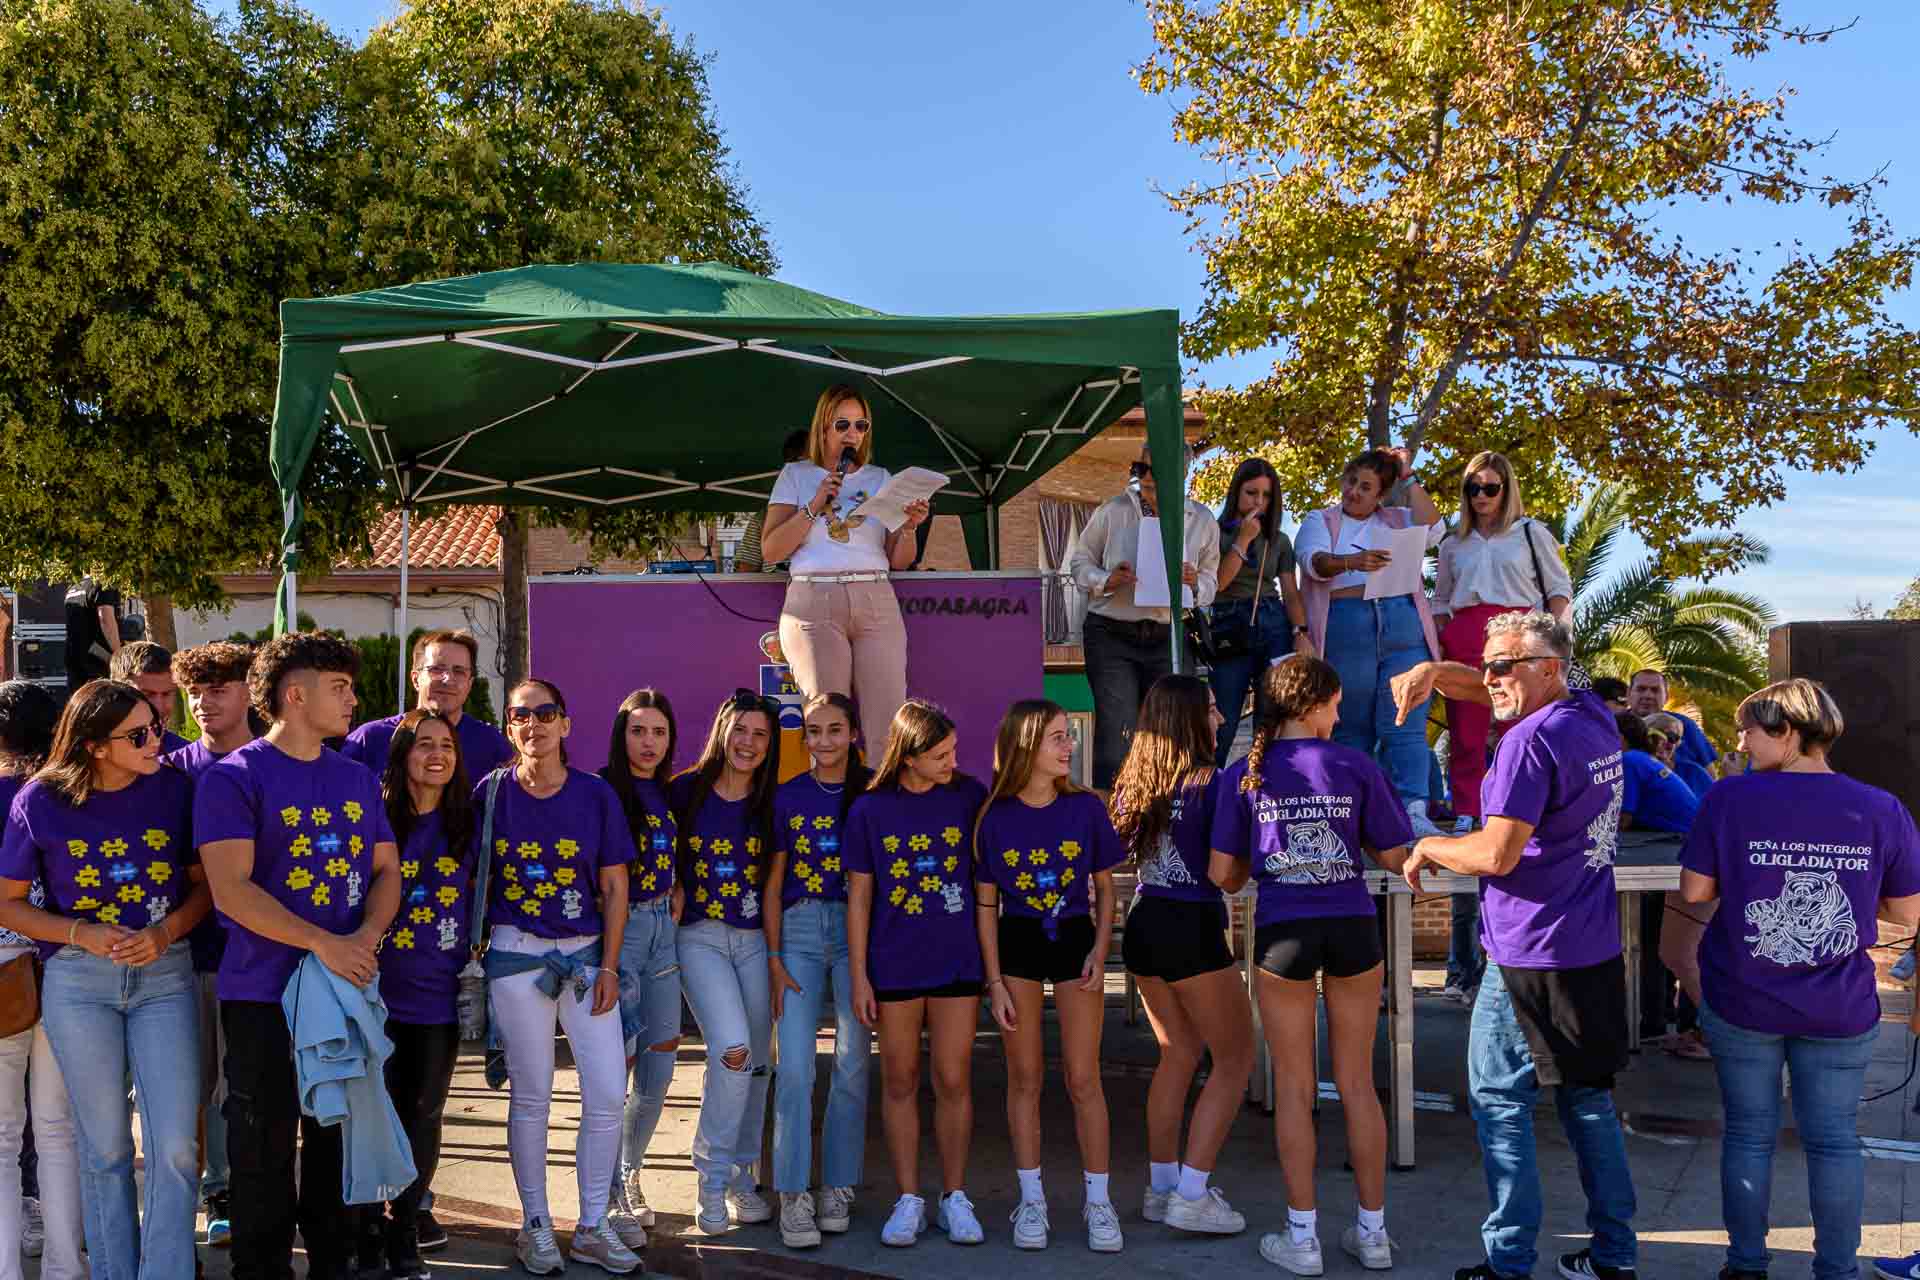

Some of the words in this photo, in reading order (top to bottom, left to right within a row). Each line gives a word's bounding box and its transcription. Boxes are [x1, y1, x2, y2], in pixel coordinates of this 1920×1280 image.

[1255, 799, 1278, 811] PEÑA
[1279, 797, 1298, 806] LOS
[1300, 795, 1353, 805] INTEGRAOS
[1258, 807, 1350, 823] OLIGLADIATOR
[1749, 840, 1779, 850] PEÑA
[1782, 842, 1805, 852] LOS
[1807, 843, 1872, 856] INTEGRAOS
[1749, 853, 1869, 871] OLIGLADIATOR
